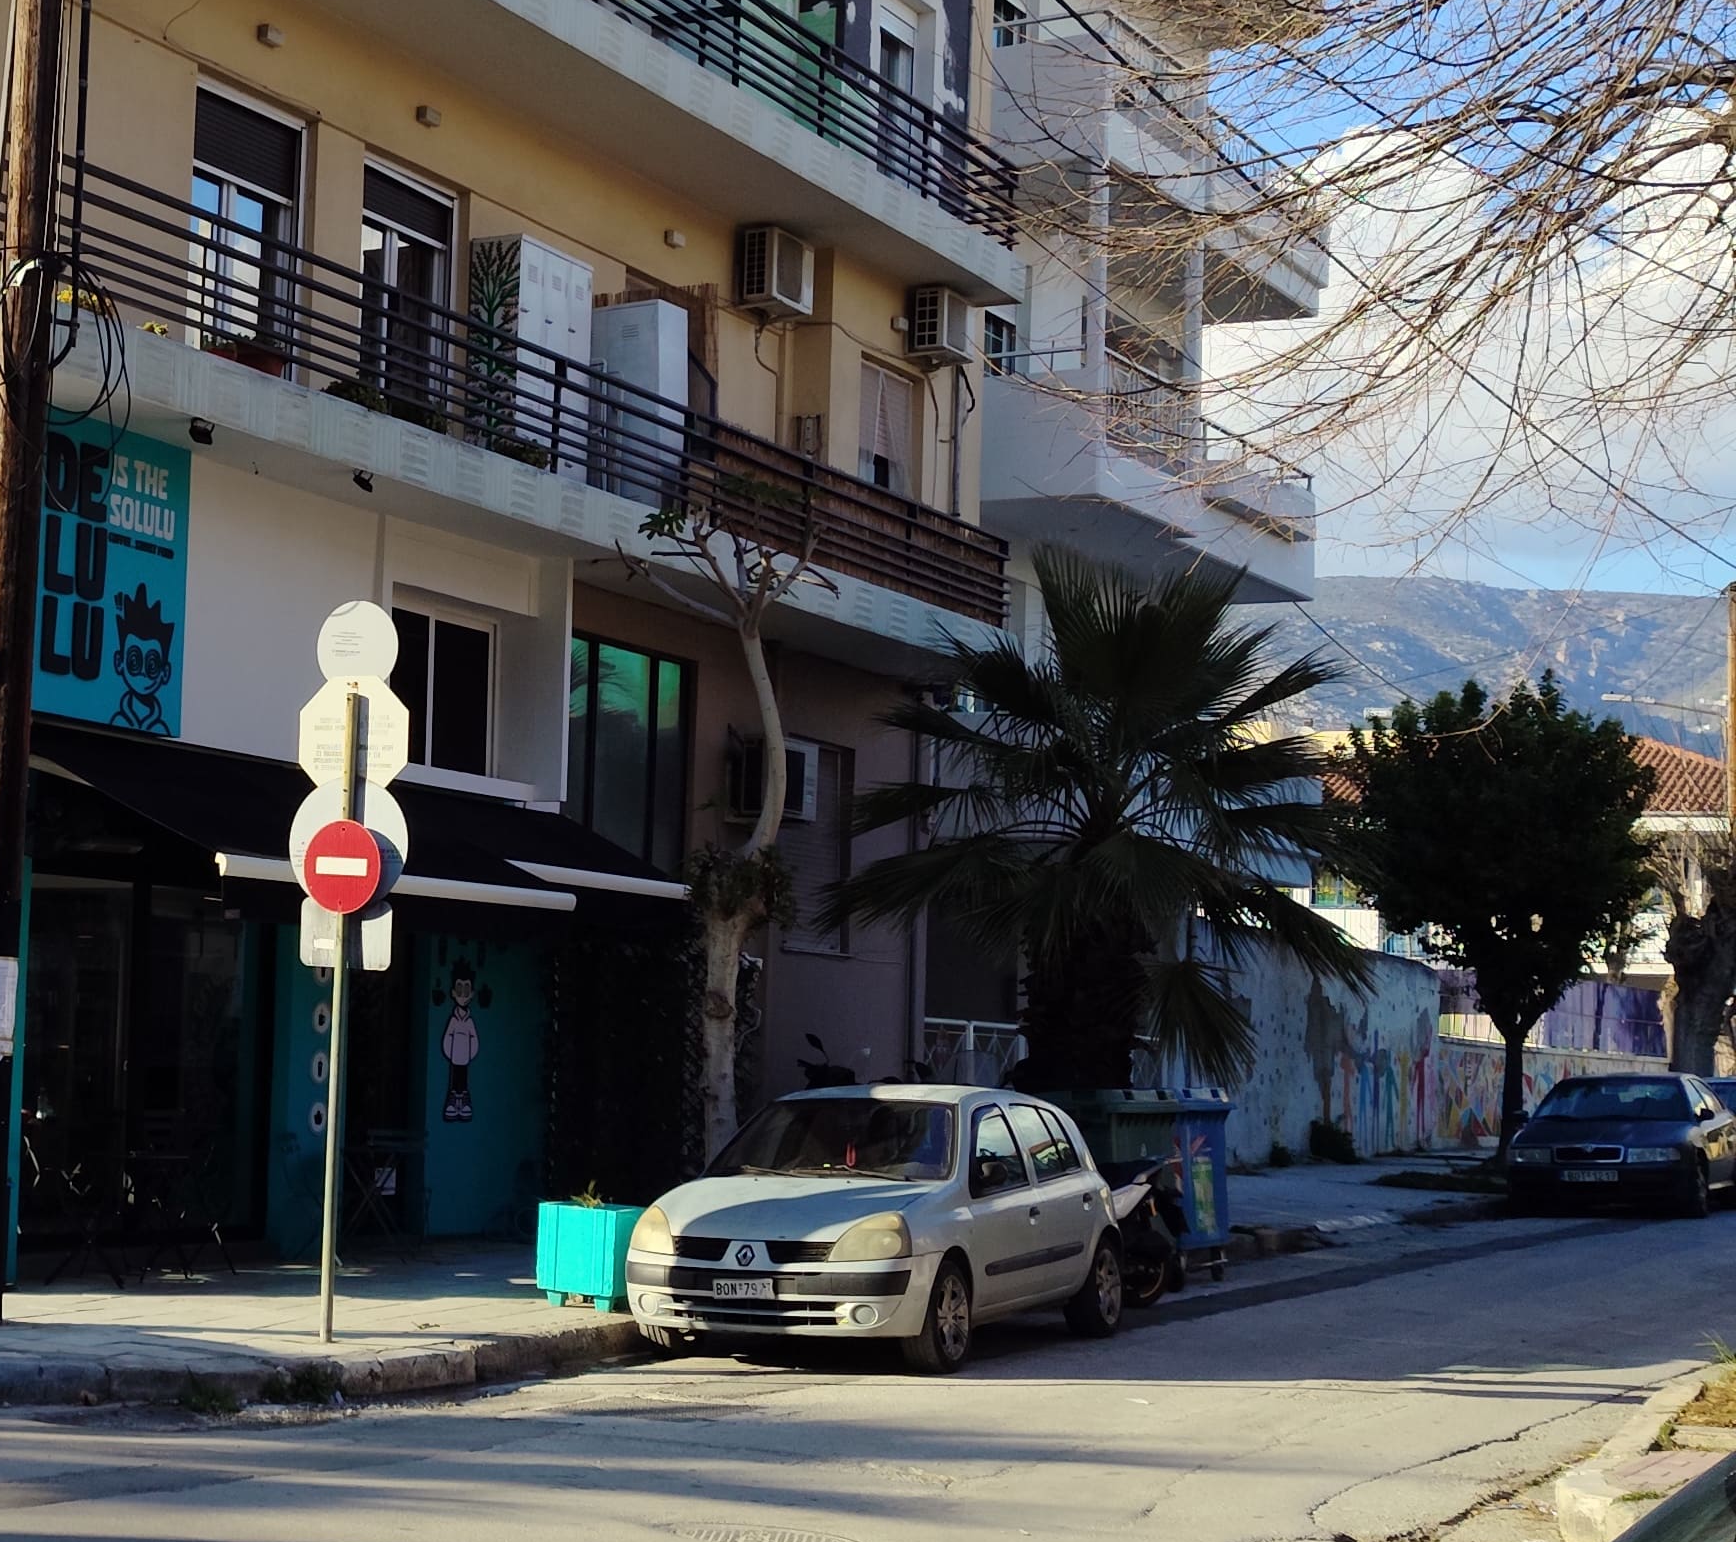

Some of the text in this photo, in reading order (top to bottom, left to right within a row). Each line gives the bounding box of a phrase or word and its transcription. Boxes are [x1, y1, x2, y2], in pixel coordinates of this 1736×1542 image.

[45, 431, 109, 523] DE
[109, 493, 176, 541] SOLULU
[112, 453, 169, 500] IS THE
[44, 514, 108, 602] LU
[40, 594, 105, 681] LU
